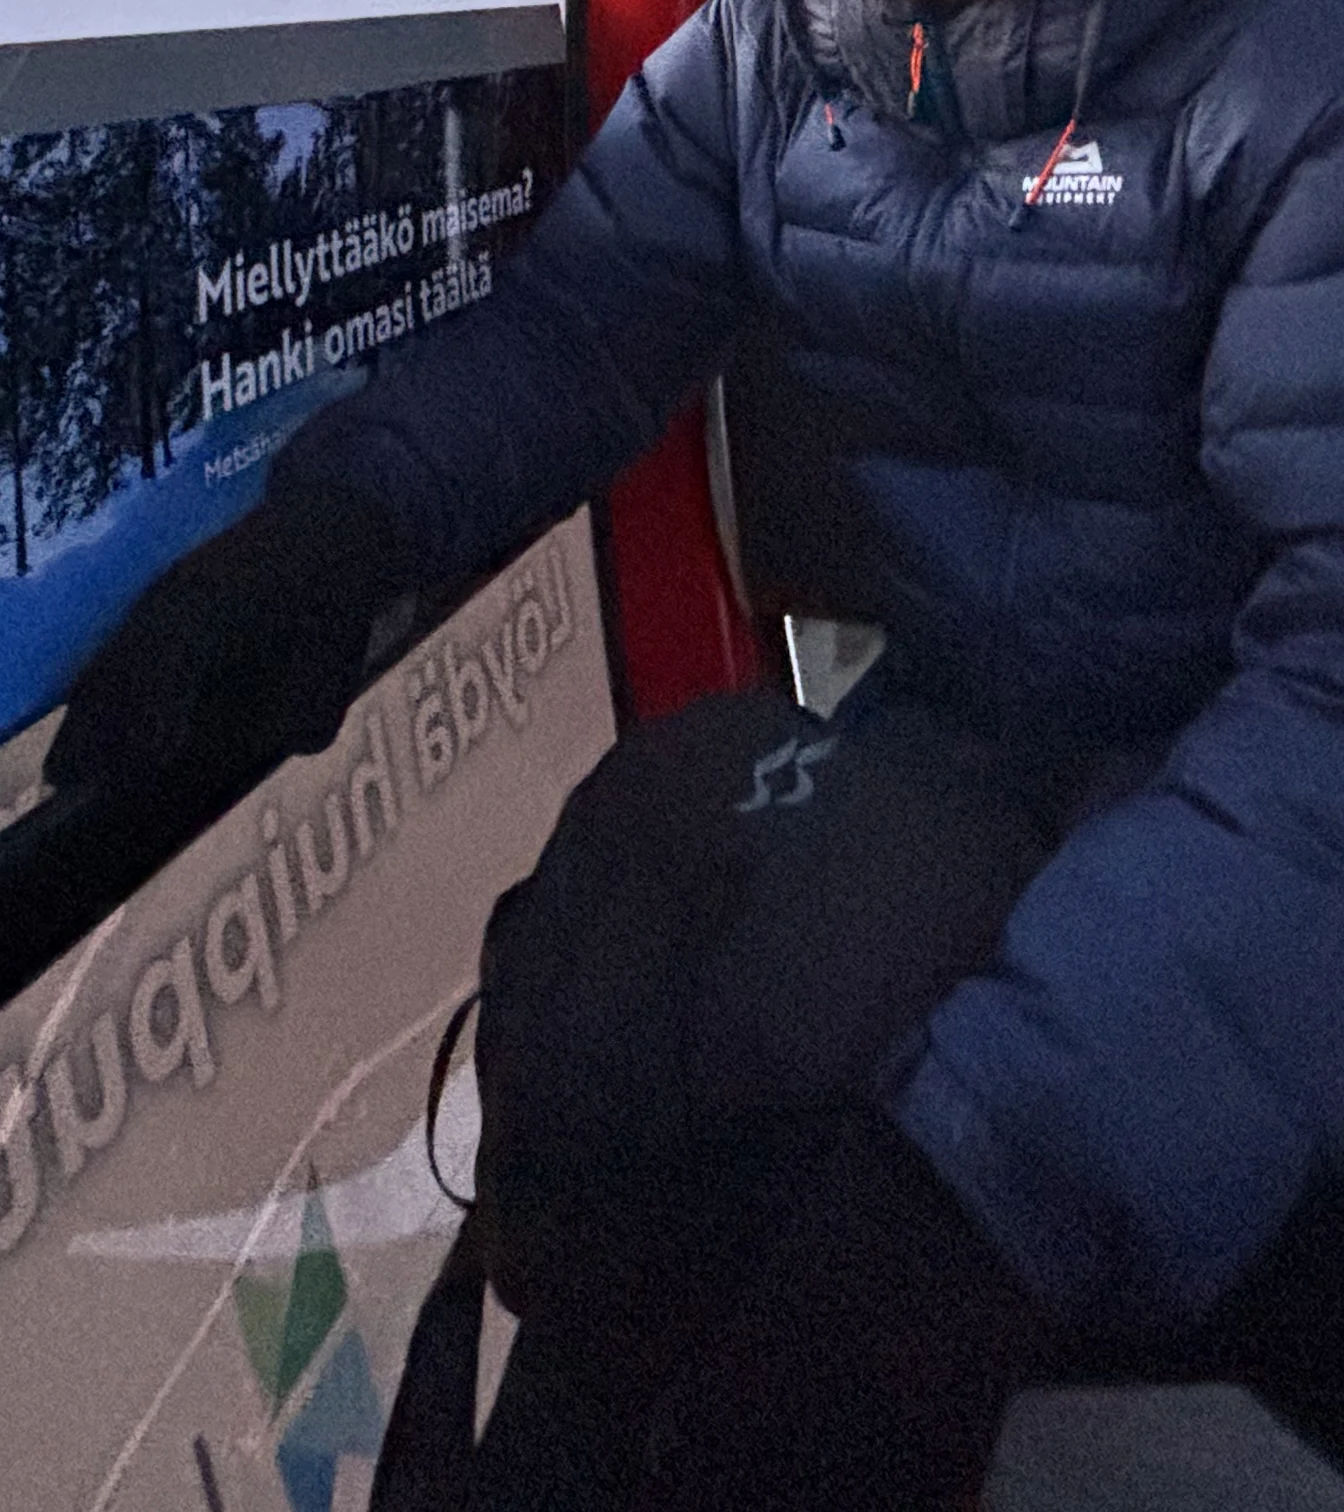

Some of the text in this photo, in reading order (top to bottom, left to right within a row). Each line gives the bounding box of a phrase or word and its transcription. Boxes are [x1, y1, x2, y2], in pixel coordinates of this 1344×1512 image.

[196, 166, 534, 324] Miellyttääkö maisema?
[201, 250, 493, 421] Hanki omasi täältä
